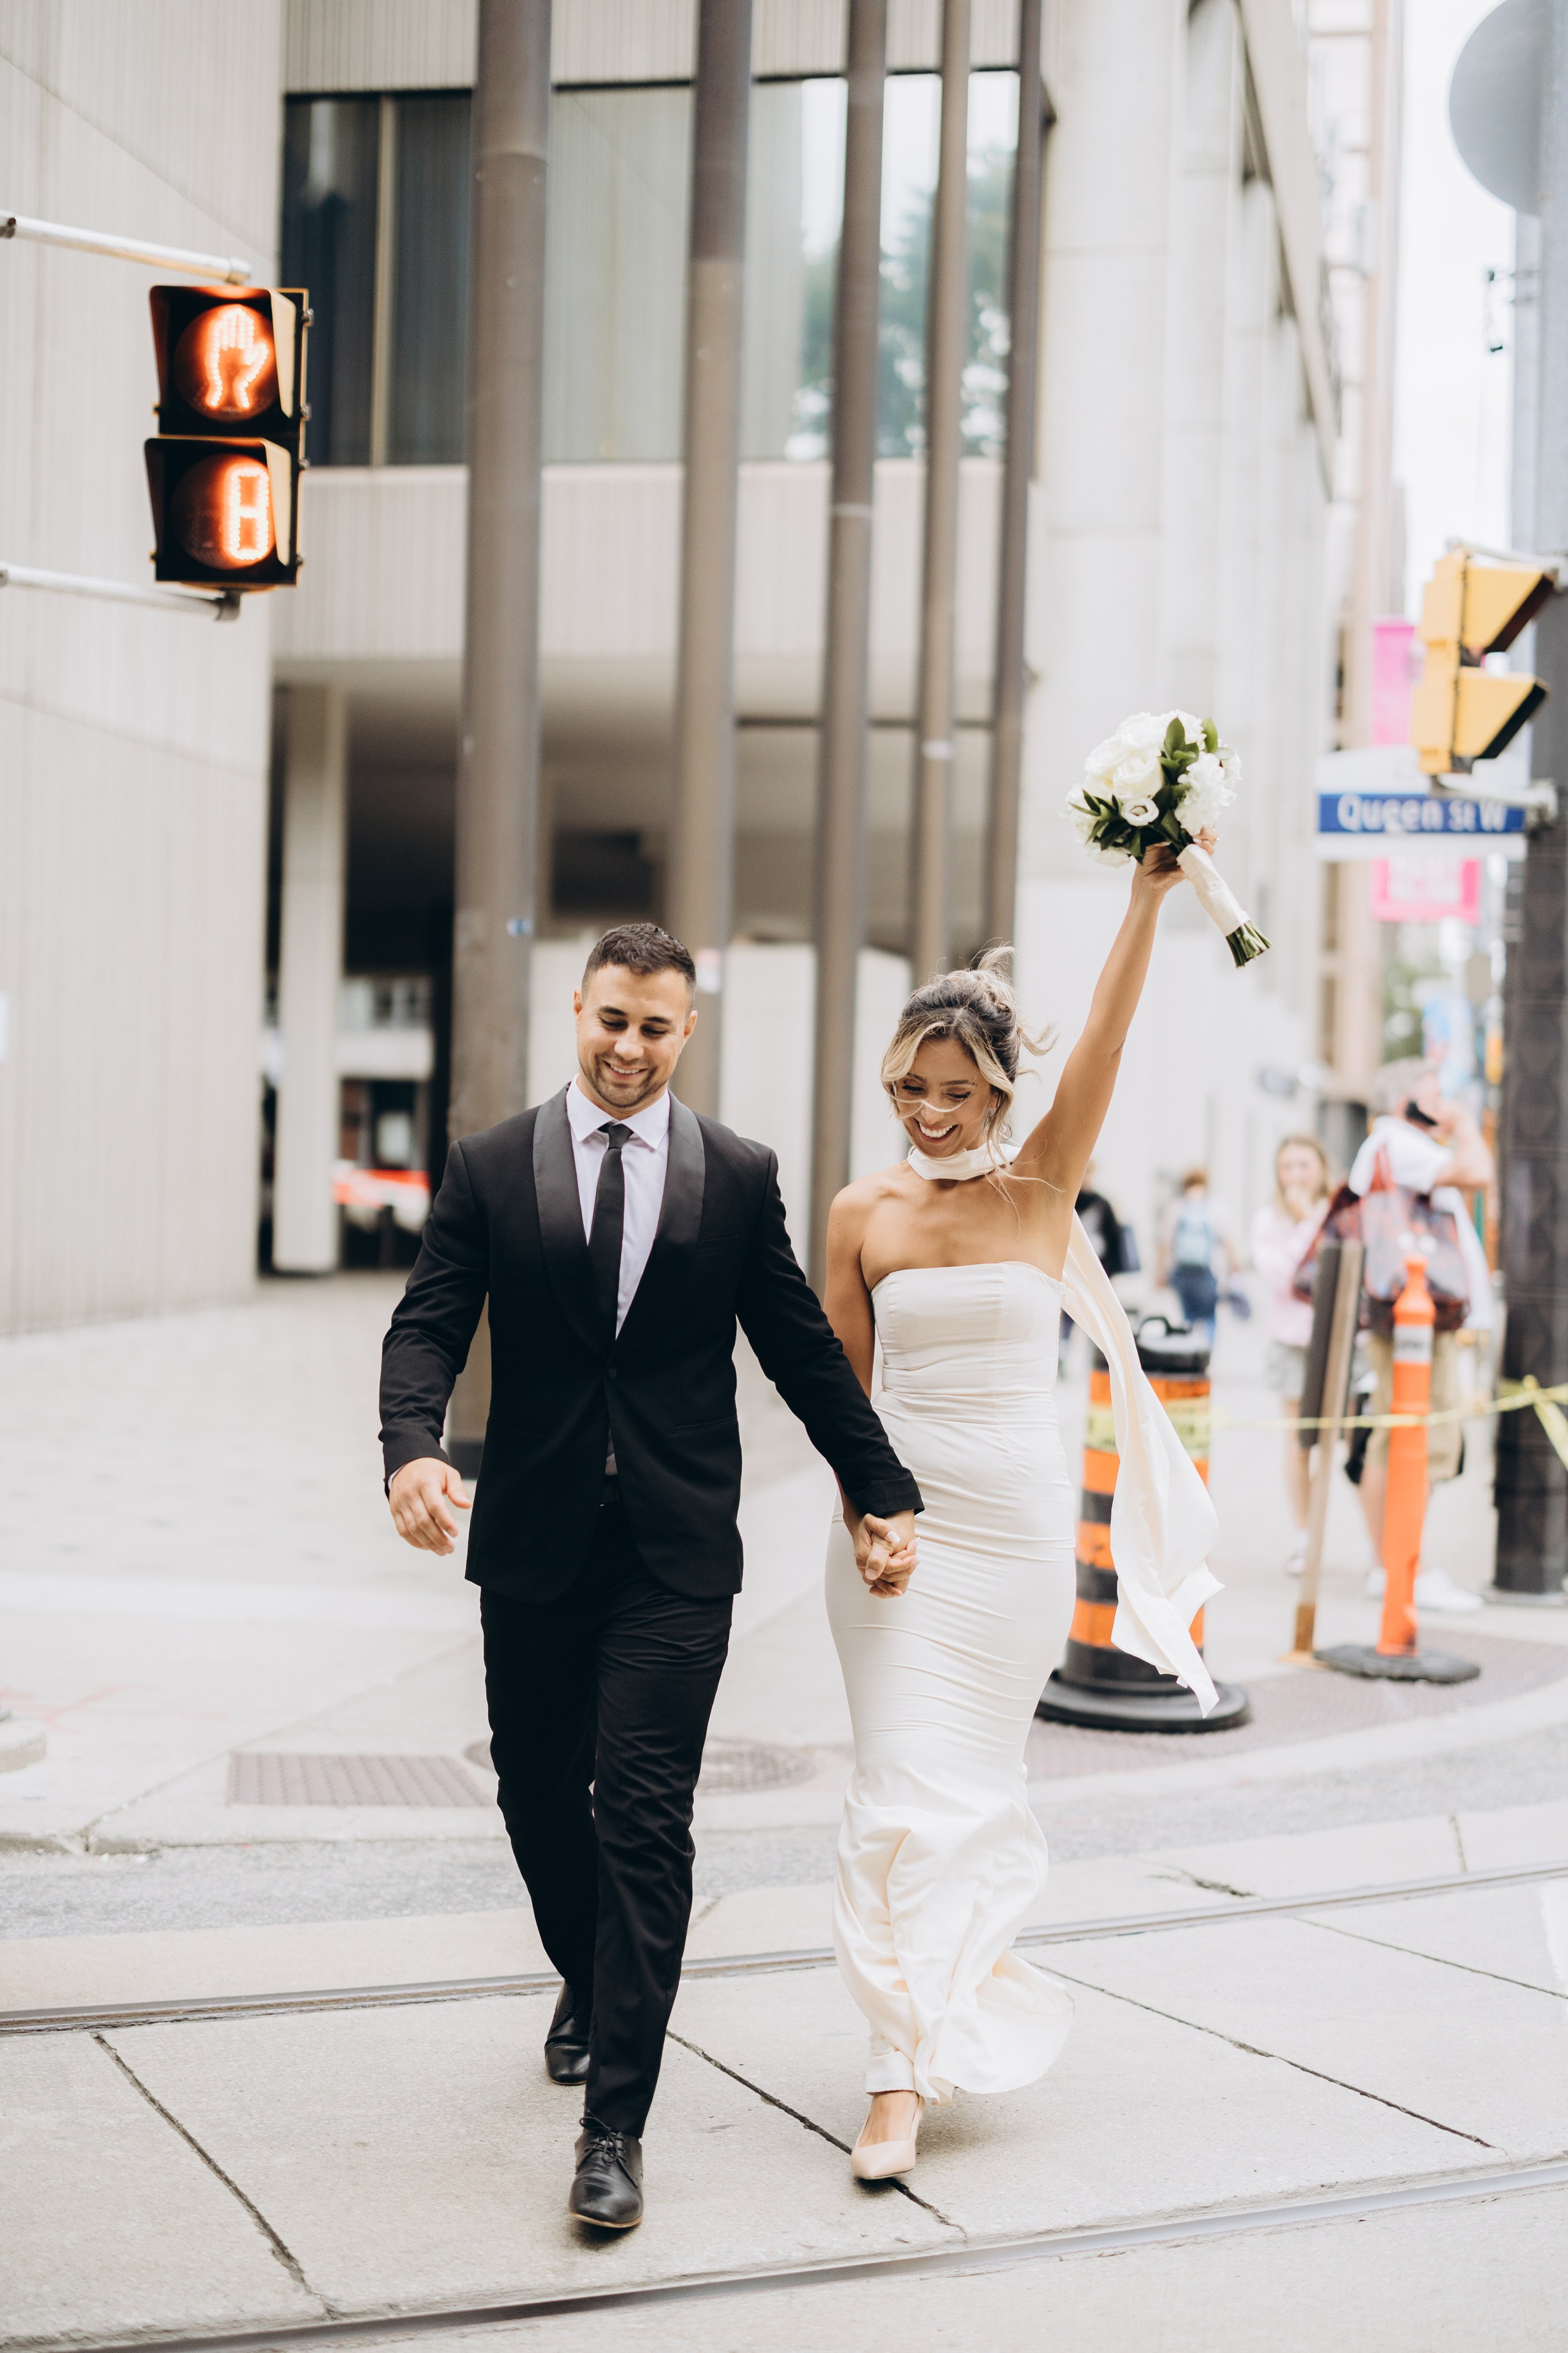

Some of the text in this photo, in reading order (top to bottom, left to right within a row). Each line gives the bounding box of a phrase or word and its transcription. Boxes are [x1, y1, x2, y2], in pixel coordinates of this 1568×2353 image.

[228, 466, 270, 561] 8
[1337, 795, 1444, 831] Queen
[1478, 799, 1507, 831] W
